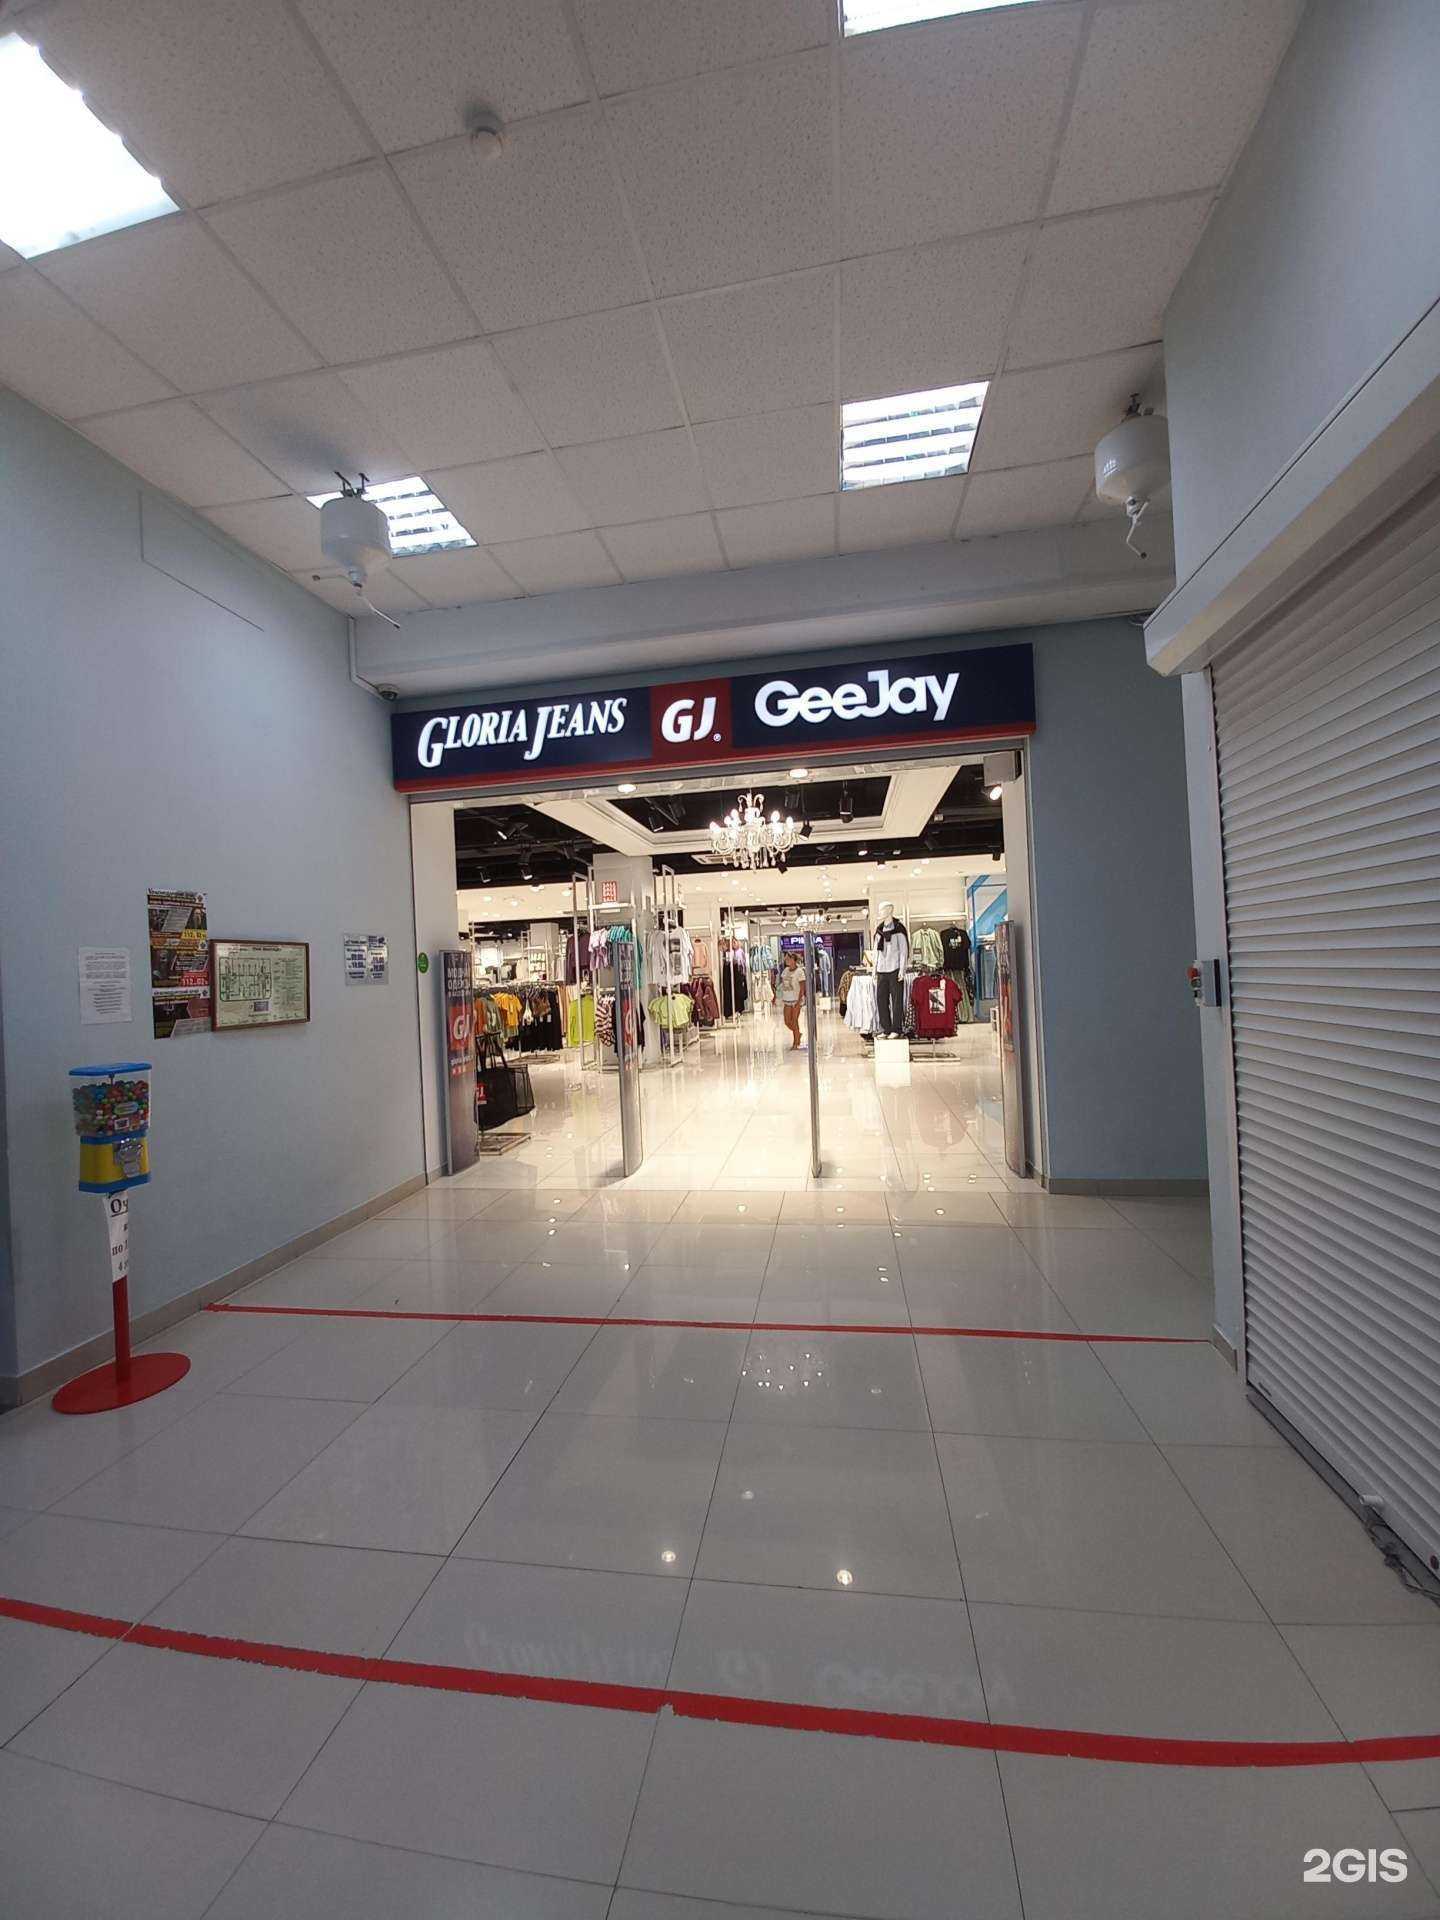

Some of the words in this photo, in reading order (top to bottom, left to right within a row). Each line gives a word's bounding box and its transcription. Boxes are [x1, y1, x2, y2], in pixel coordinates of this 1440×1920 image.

[661, 696, 717, 743] GJ
[754, 669, 960, 727] GeeJay
[417, 709, 528, 768] GLORIA
[523, 697, 627, 761] JEANS
